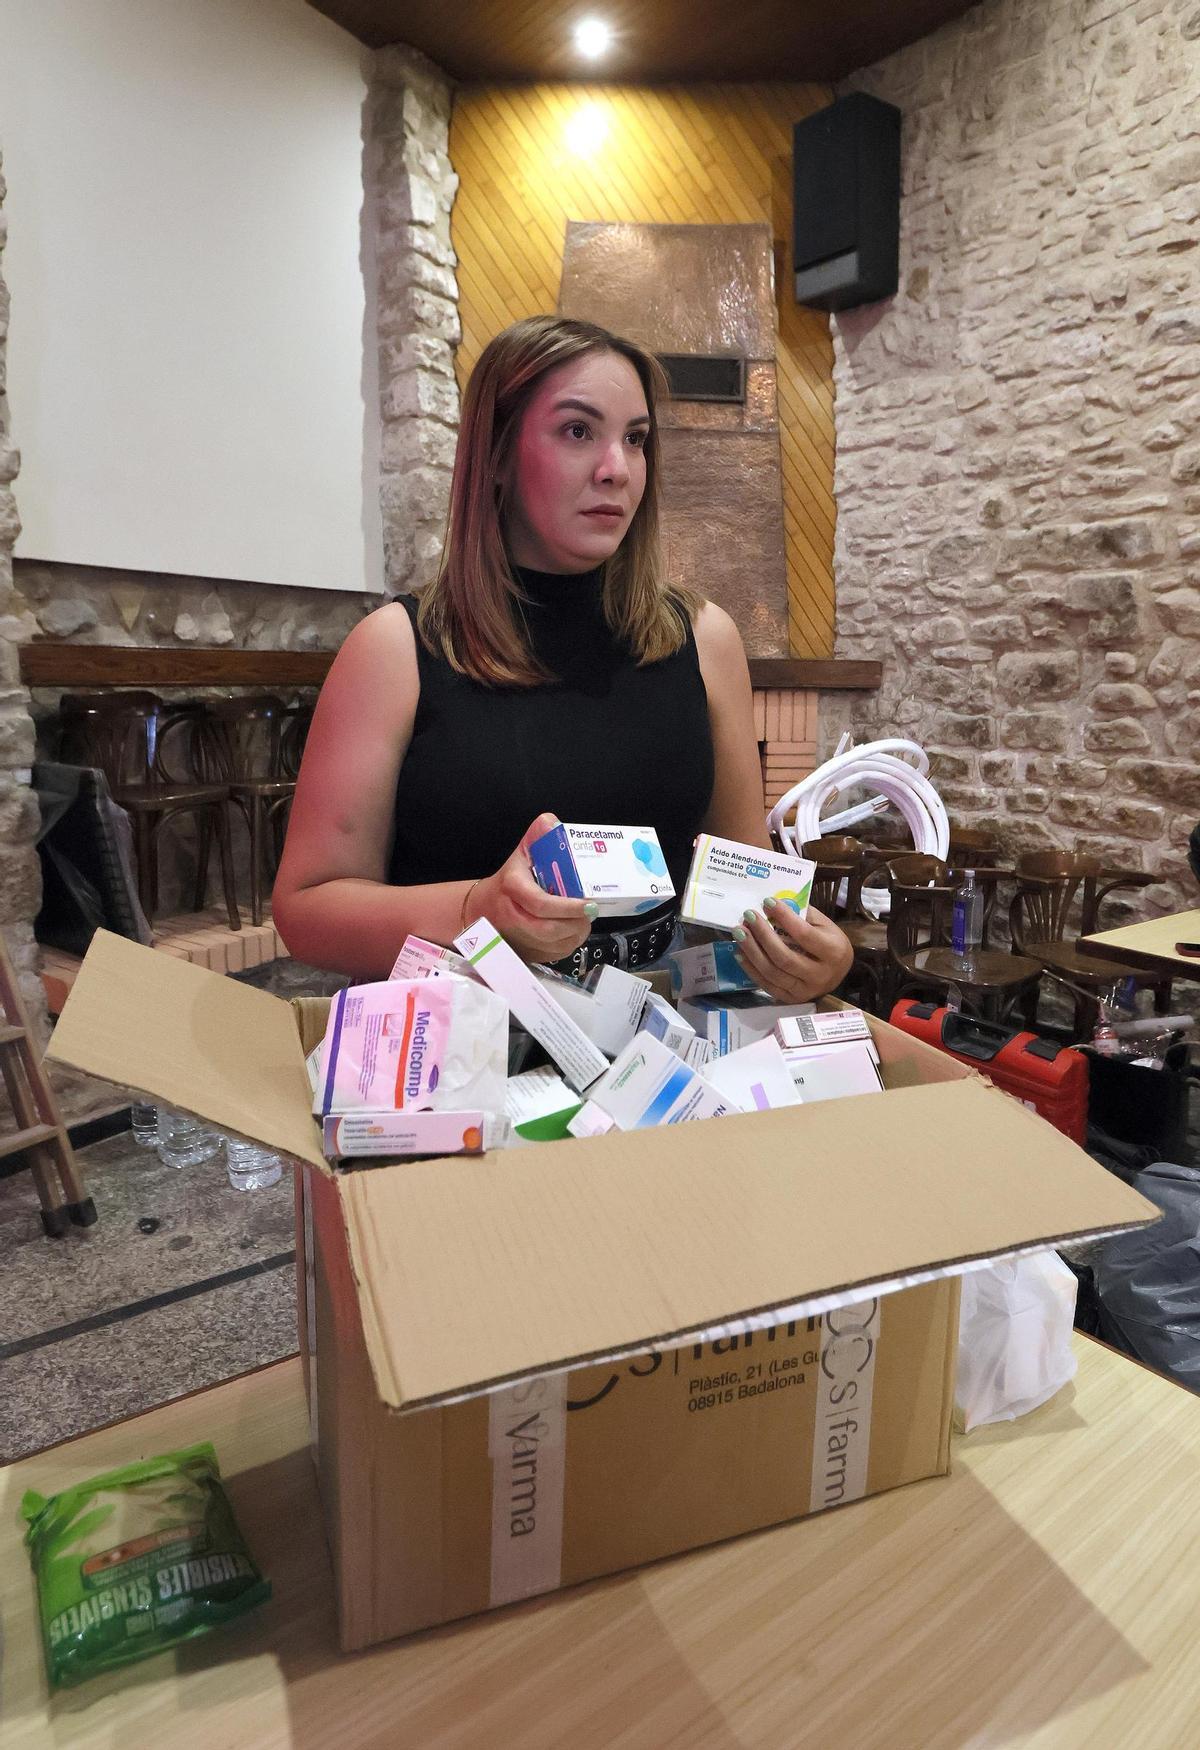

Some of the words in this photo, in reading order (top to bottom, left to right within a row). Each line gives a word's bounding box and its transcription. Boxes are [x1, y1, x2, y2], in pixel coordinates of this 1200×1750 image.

[569, 828, 624, 840] Paracetamol
[574, 841, 593, 851] cinfa
[709, 855, 744, 871] Teva-ratio
[747, 865, 757, 874] 70
[757, 869, 769, 879] mg
[731, 852, 771, 869] Alendrónico
[773, 864, 802, 877] semanal
[406, 1010, 431, 1098] Medicomp
[689, 1370, 741, 1395] Plàstic,
[746, 1363, 762, 1379] 21
[768, 1354, 798, 1377] (Les
[687, 1388, 734, 1413] 08915
[738, 1372, 806, 1401] Badalona
